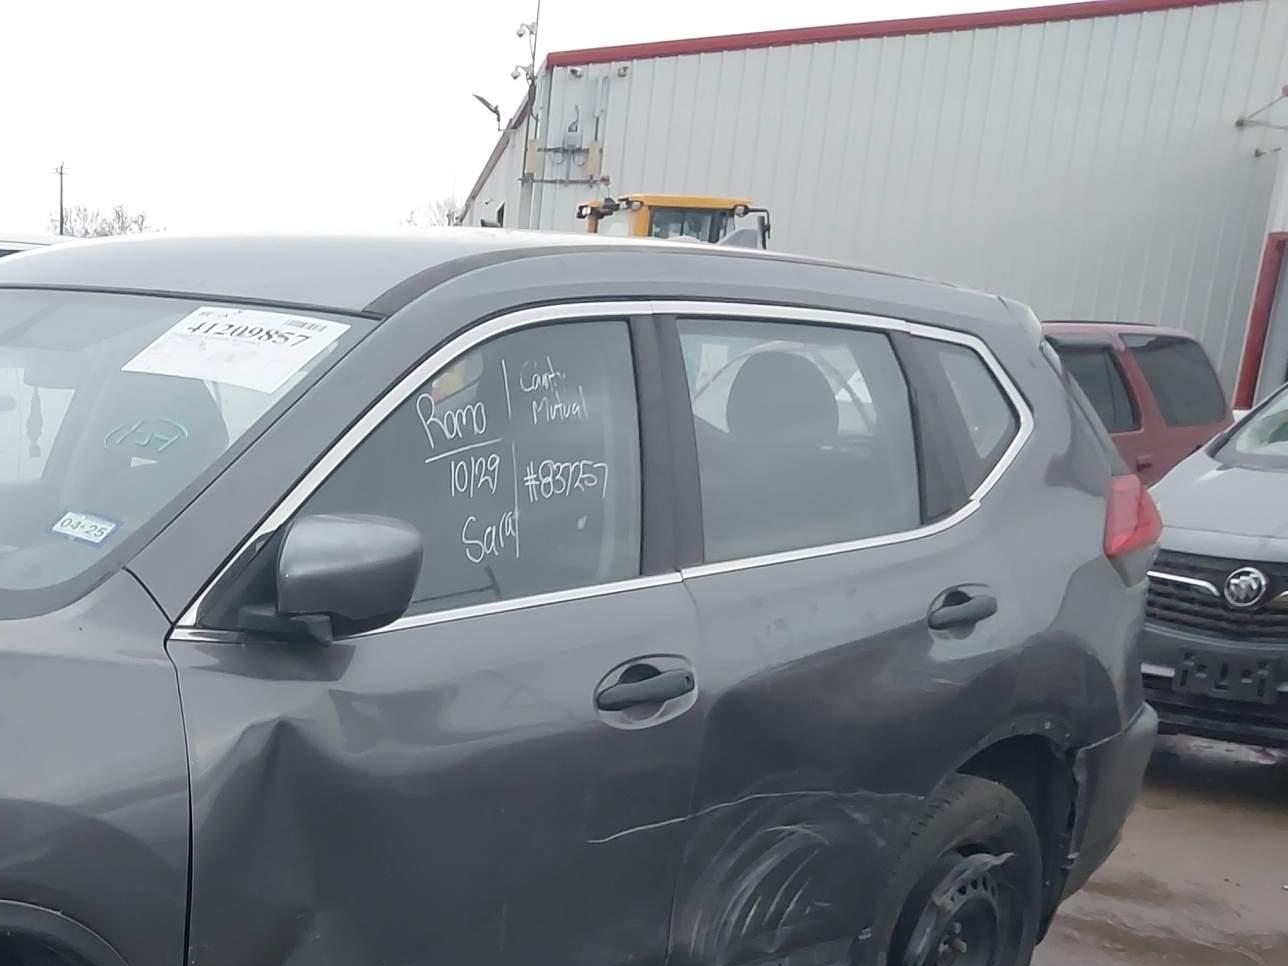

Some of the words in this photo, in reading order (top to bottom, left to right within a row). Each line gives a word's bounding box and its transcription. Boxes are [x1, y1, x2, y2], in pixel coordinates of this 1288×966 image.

[186, 320, 312, 348] 41209857
[532, 384, 589, 425] Mutual
[450, 453, 501, 498] 10/29
[523, 459, 609, 503] #837257
